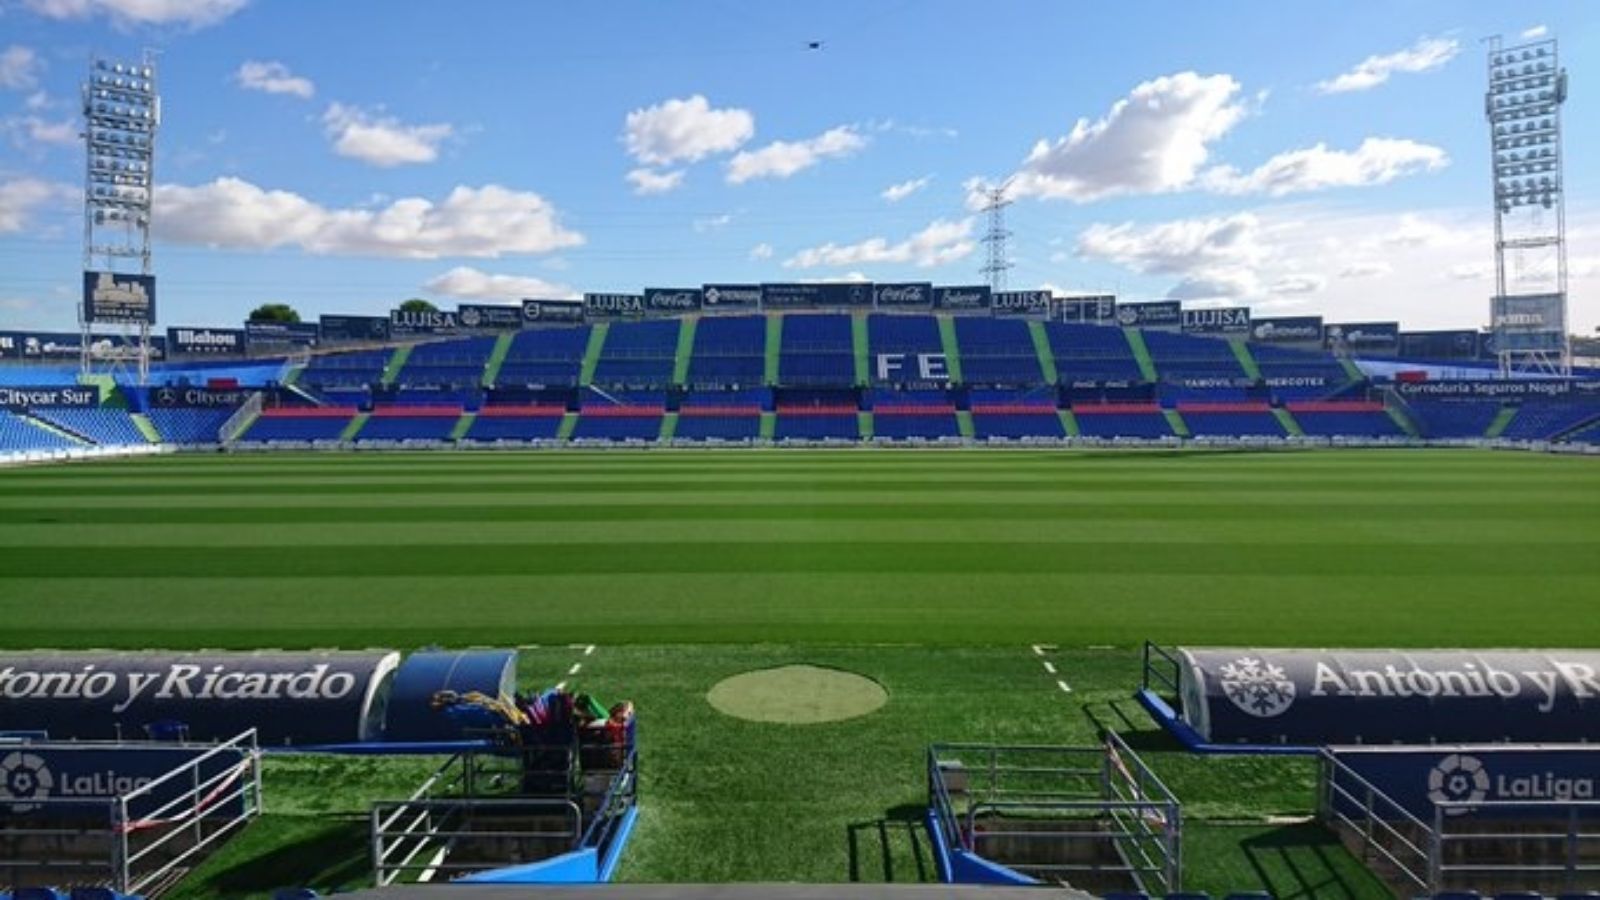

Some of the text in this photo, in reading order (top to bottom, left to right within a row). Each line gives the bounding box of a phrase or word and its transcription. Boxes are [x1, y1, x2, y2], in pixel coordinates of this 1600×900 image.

[391, 310, 456, 328] LUJISA
[1183, 309, 1249, 326] LUJISA
[177, 330, 236, 346] Mahou
[0, 389, 93, 406] Citycar Sur
[185, 389, 240, 406] Citycar
[1474, 382, 1526, 395] Seguros
[1529, 382, 1569, 396] Nogal
[112, 672, 158, 713] y
[155, 664, 356, 699] Ricardo
[1311, 661, 1522, 697] Antonio
[1522, 671, 1557, 713] y
[1498, 772, 1594, 801] LaLiga
